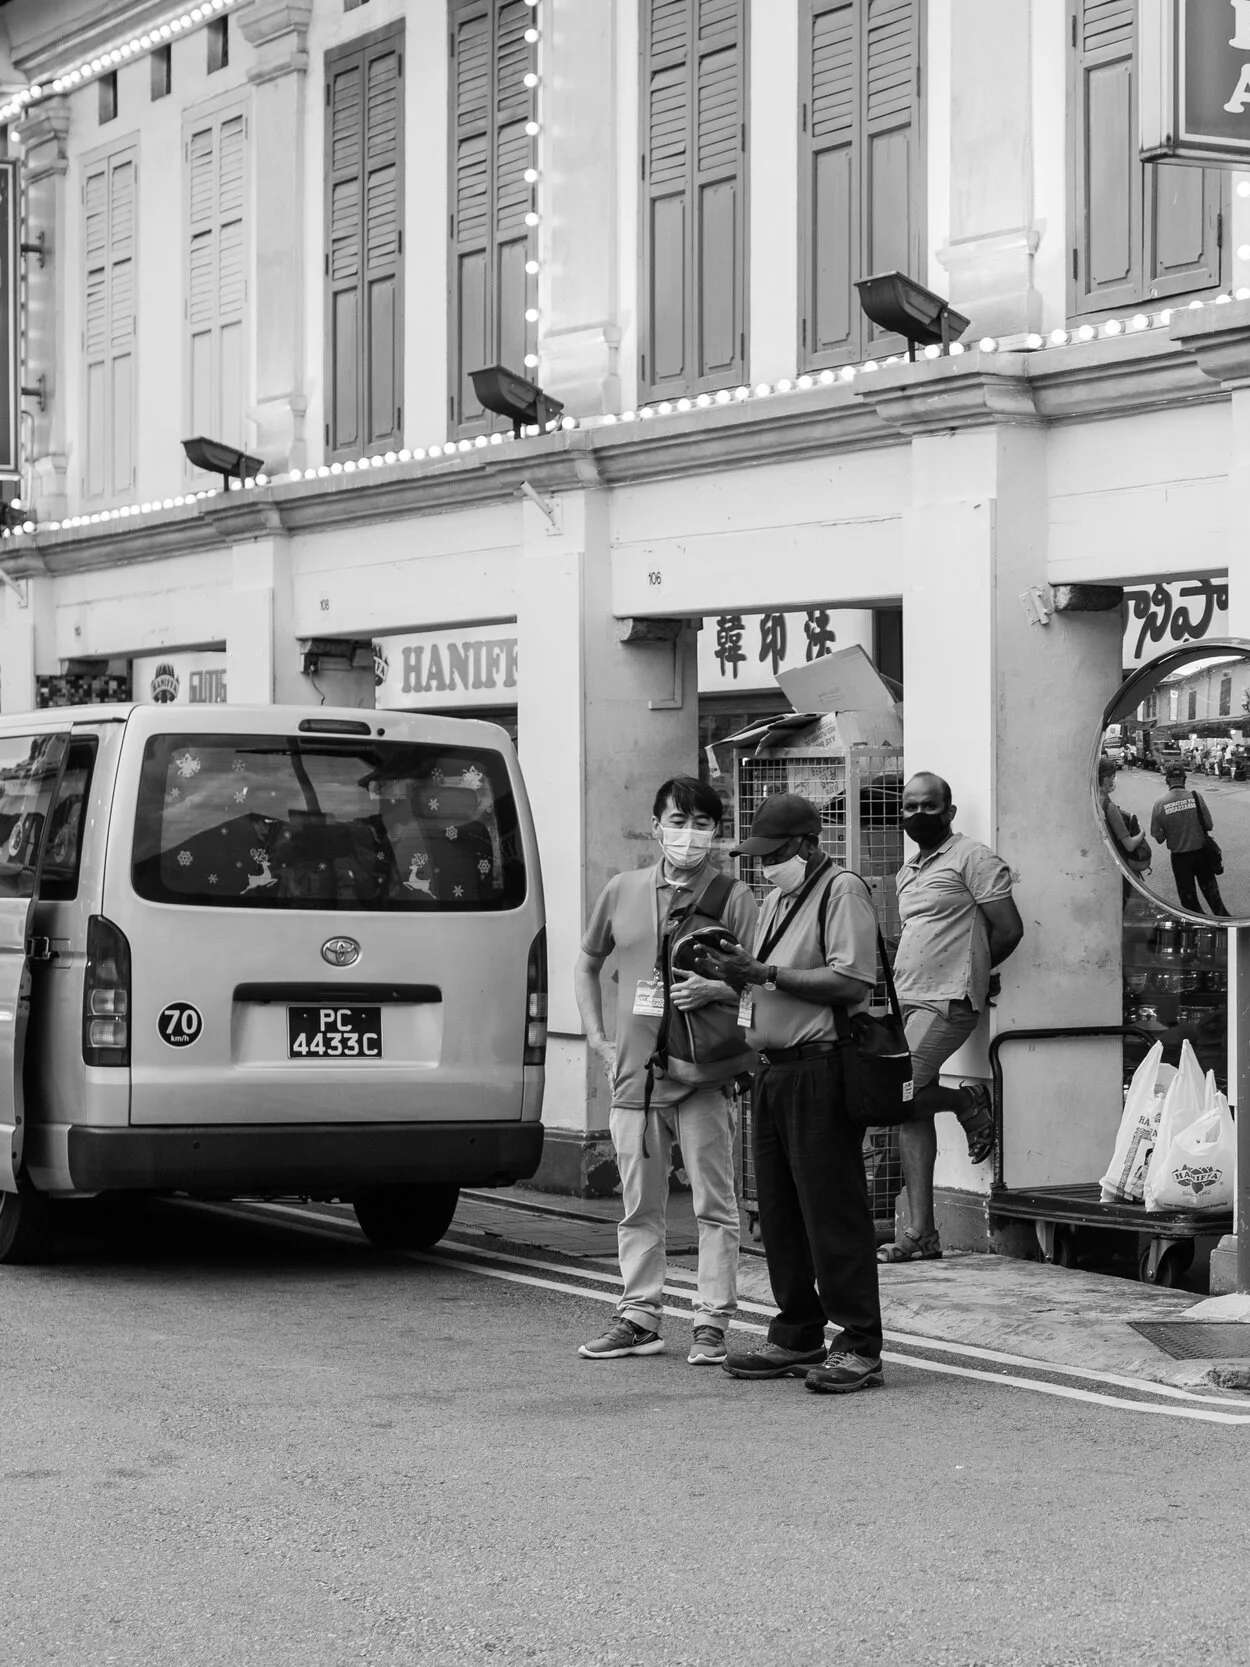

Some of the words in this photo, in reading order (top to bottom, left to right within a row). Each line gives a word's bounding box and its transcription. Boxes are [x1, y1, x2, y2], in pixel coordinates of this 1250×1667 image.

[648, 571, 662, 585] 106
[320, 599, 329, 612] 108
[164, 1010, 198, 1034] 70
[320, 1009, 352, 1031] PC
[171, 1034, 189, 1042] km/h
[293, 1033, 378, 1055] 4433C
